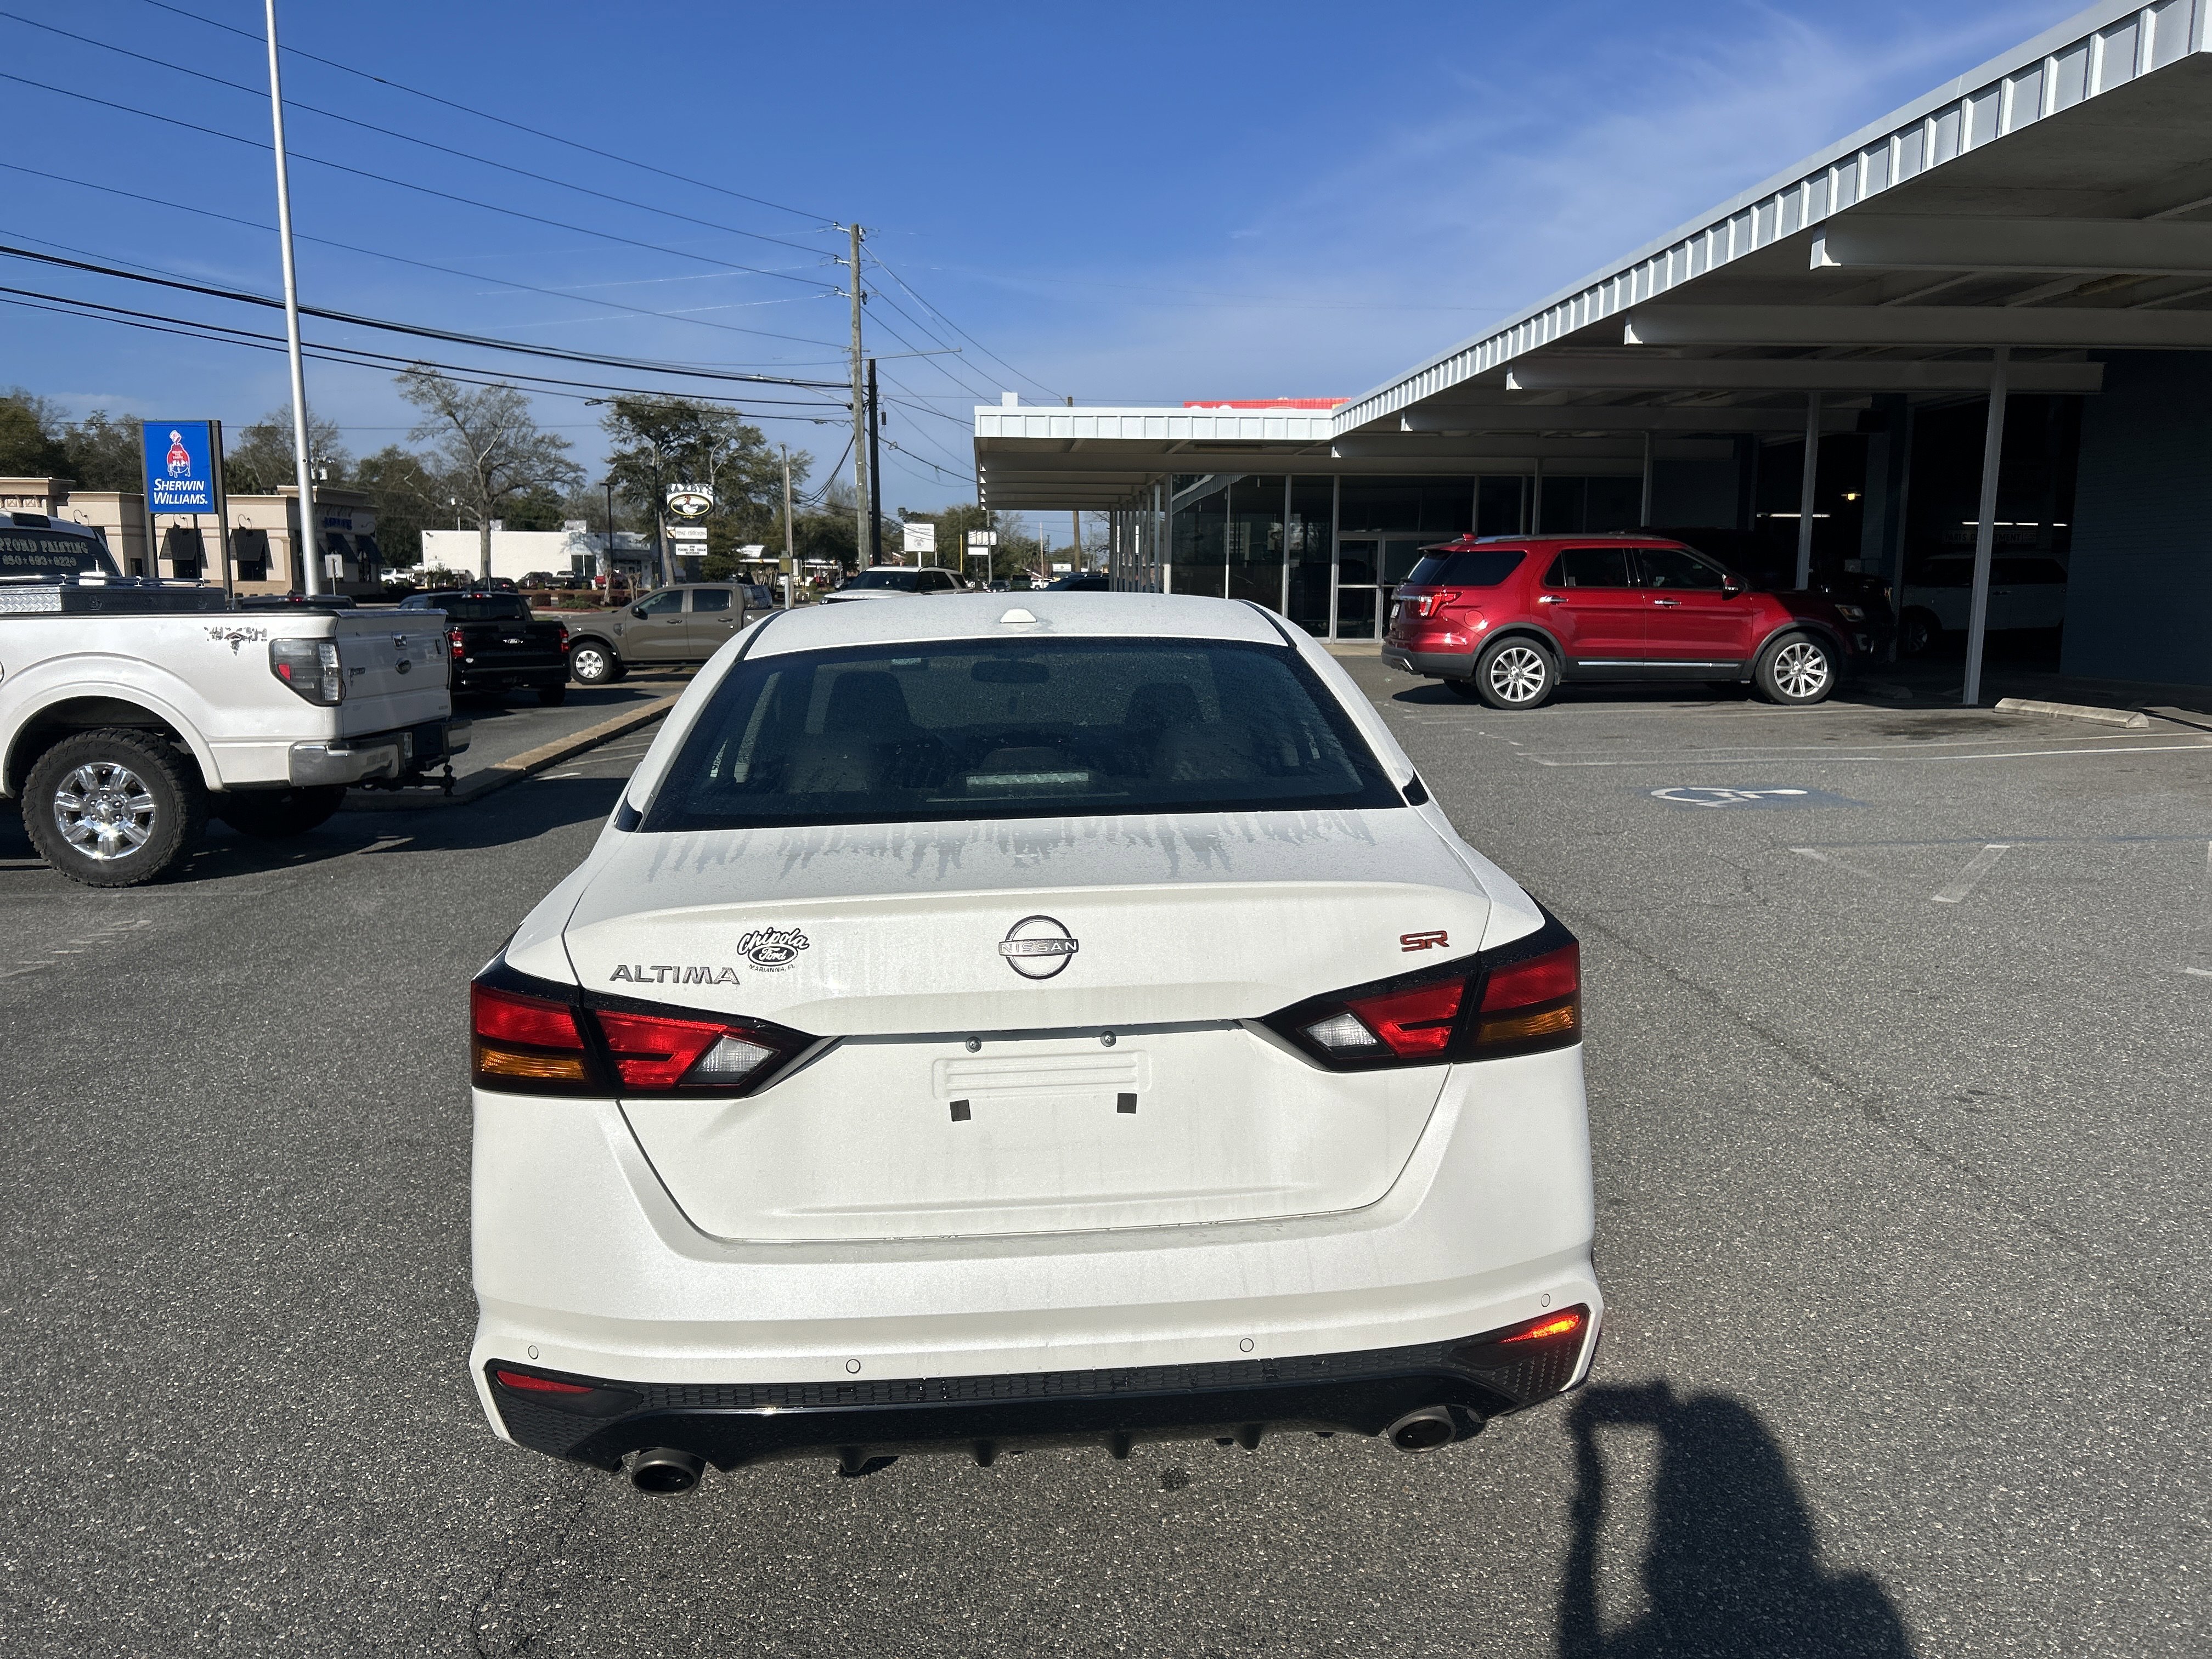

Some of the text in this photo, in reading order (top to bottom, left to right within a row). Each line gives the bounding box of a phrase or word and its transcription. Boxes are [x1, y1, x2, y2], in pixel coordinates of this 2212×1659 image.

[154, 478, 204, 491] SHERWIN
[154, 492, 206, 504] WILLIAMS
[1971, 533, 2021, 541] DTMENT
[736, 926, 810, 955] Chipola
[1000, 941, 1077, 953] NISSAN
[1400, 930, 1450, 952] SR
[758, 947, 788, 961] Ford
[609, 964, 741, 985] ALTIMA
[748, 964, 787, 973] MARIANNA,
